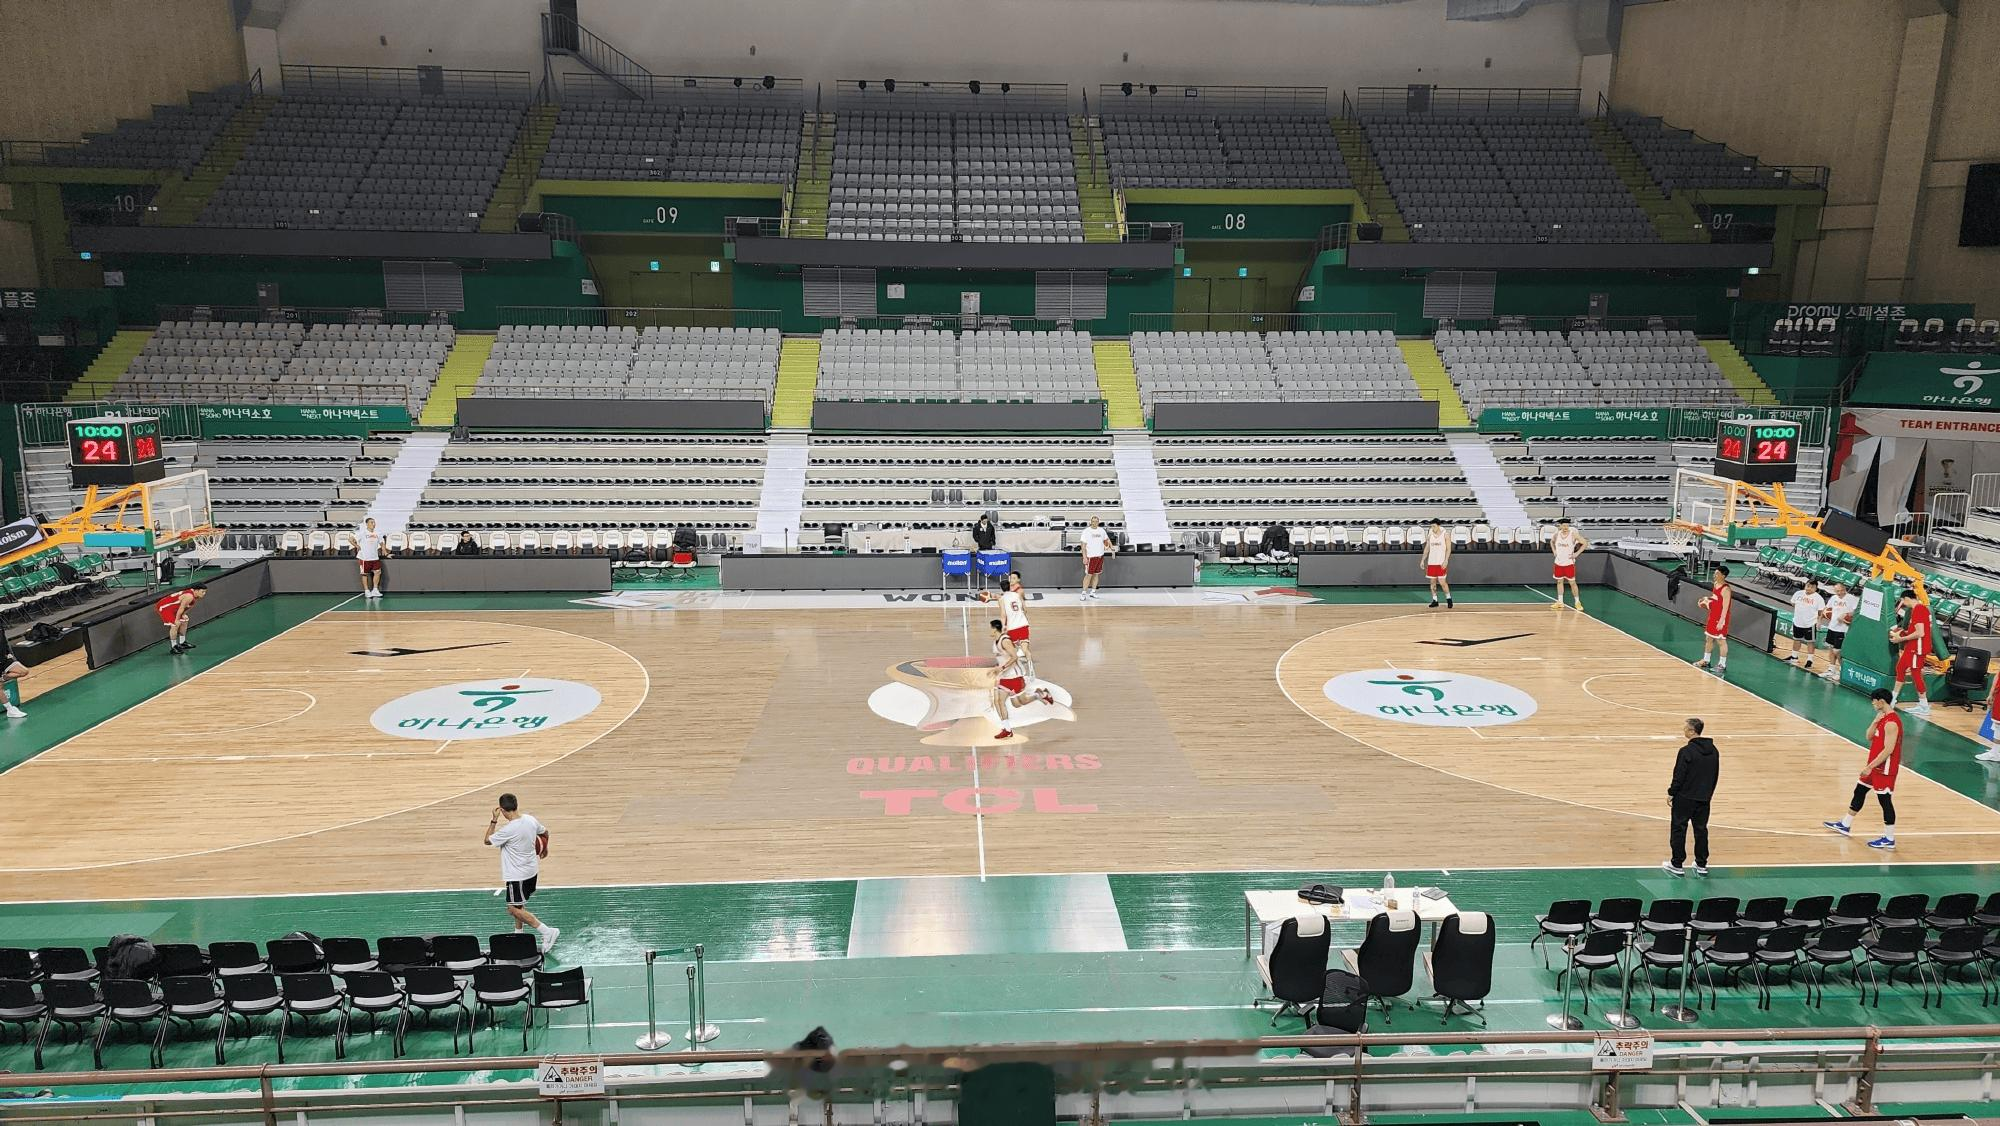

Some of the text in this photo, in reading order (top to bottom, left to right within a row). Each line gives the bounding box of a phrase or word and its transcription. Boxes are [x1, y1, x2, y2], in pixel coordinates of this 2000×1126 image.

[114, 195, 135, 213] 10
[656, 206, 678, 224] 09
[1225, 213, 1246, 230] 08
[1713, 213, 1733, 230] 07
[0, 290, 36, 310] 플존
[1845, 305, 1907, 321] 스페셜존
[1923, 395, 1993, 406] 하나은행
[75, 425, 123, 438] 10:00
[1755, 427, 1795, 438] 10:00
[1900, 419, 2000, 434] TEAM ENTRANCE
[83, 440, 117, 461] 24
[1757, 440, 1788, 460] 24
[0, 529, 28, 545] oism
[1010, 601, 1019, 612] 6
[1376, 704, 1519, 718] 하나은행
[397, 715, 549, 731] 하나은행
[846, 753, 1103, 776] QUALIFIERS
[859, 786, 1099, 816] TCL
[1615, 1040, 1649, 1050] 추락주의
[560, 1065, 598, 1076] 추락주의
[565, 1075, 593, 1083] DANGER
